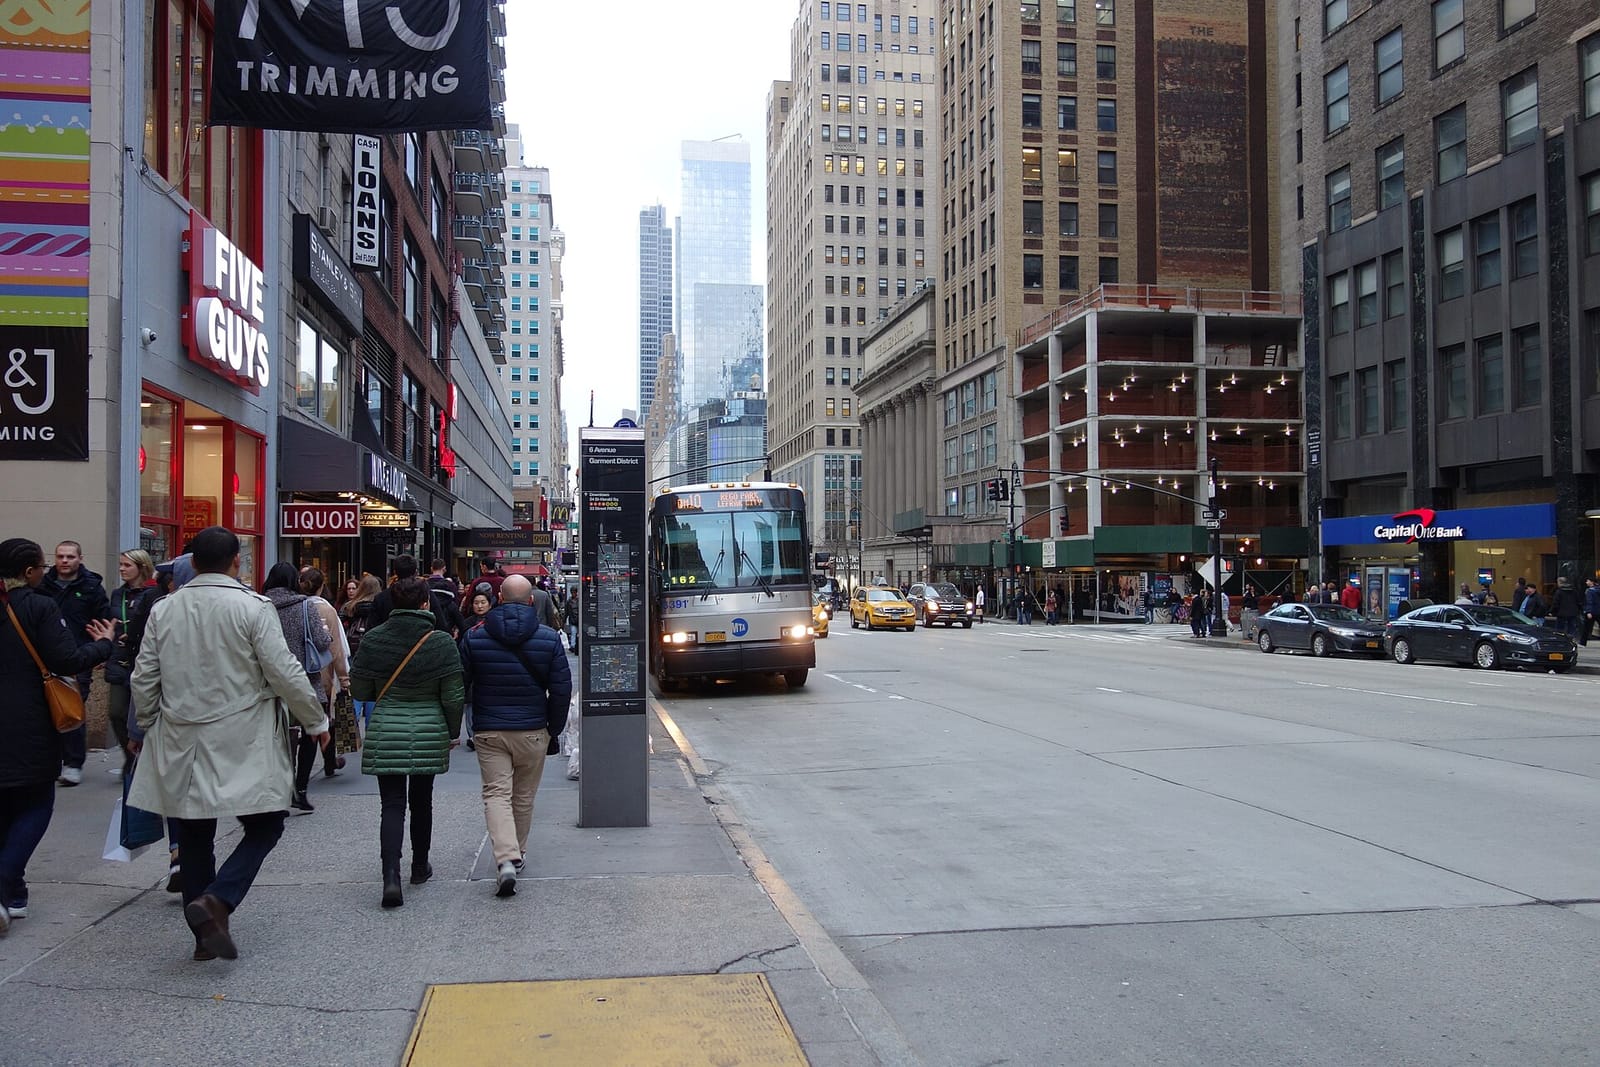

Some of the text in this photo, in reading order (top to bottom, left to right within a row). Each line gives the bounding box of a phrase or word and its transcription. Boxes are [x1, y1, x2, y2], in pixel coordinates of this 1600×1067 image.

[1189, 25, 1214, 36] THE
[237, 61, 459, 100] TRIMMING
[357, 138, 378, 149] CASH
[356, 151, 377, 250] LOANS
[363, 253, 376, 264] FLOOR
[214, 229, 265, 323] FIVE
[207, 297, 270, 388] GUYS
[0, 348, 55, 414] &J
[589, 457, 616, 465] Garment
[283, 510, 356, 530] LIQUOR
[1374, 523, 1464, 540] Capital One Bank
[534, 535, 549, 544] 990
[671, 575, 696, 585] 162
[731, 621, 746, 634] MTA
